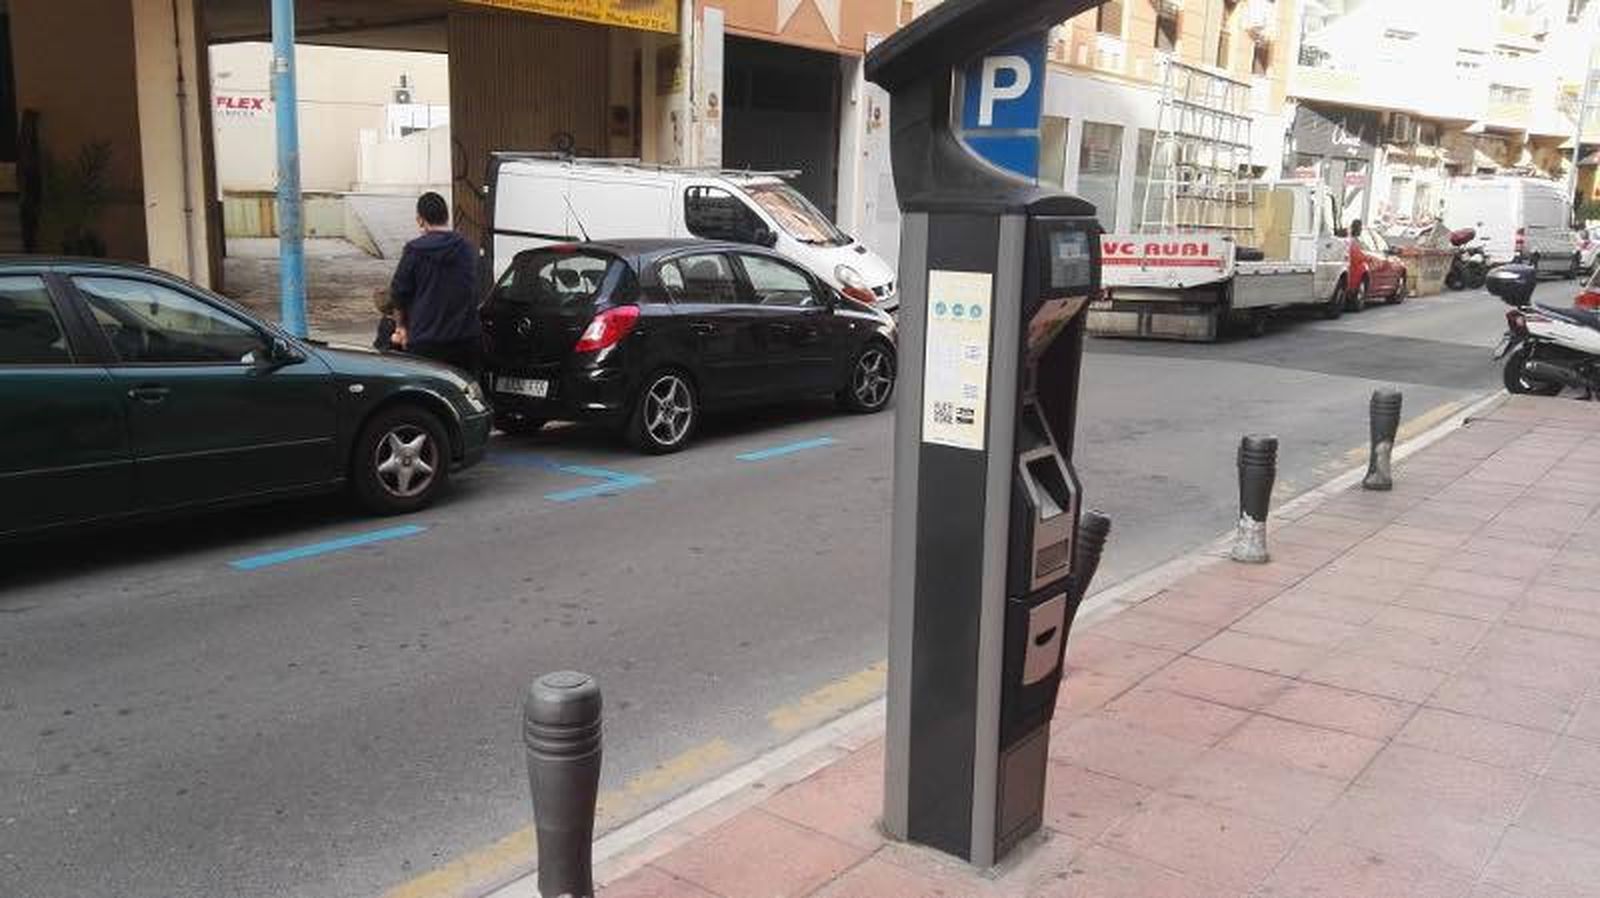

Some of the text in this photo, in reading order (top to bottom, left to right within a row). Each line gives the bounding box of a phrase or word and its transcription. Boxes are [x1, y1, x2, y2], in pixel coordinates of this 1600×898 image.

[978, 55, 1031, 126] P
[216, 97, 264, 110] FLEX
[1144, 242, 1209, 256] RUBI
